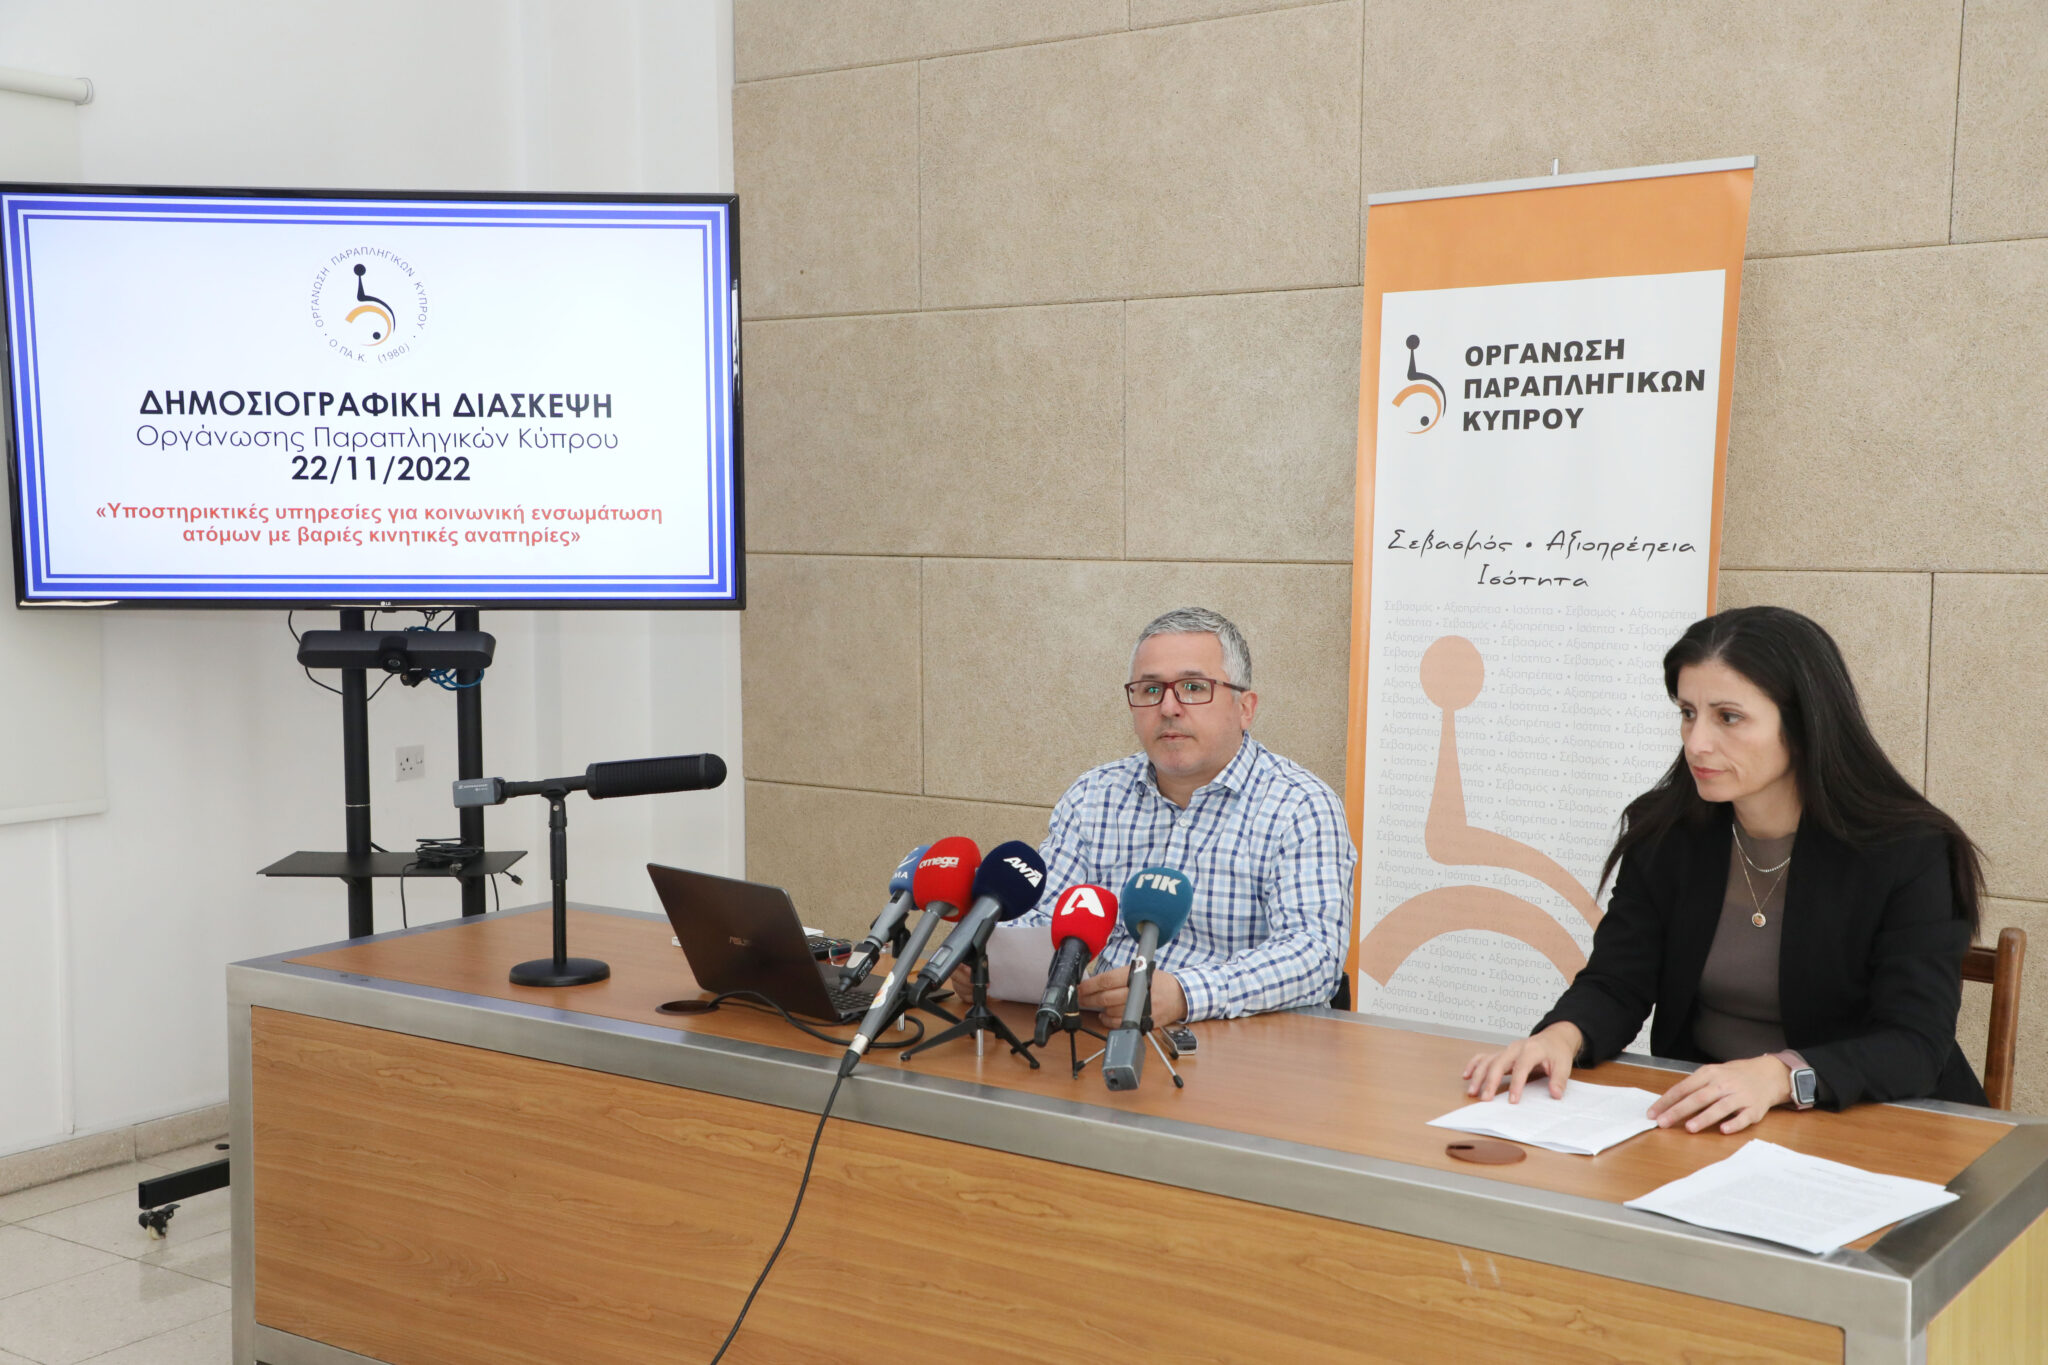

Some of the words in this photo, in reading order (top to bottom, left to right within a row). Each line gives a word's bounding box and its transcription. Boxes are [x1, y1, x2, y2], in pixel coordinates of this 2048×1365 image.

[311, 267, 330, 327] ΟΡΓΑΝΩΣΗ
[330, 246, 416, 278] ΠΑΡΑΠΛΗΓΙΚΩΝ
[414, 281, 428, 330] ΚΥΠΡΟΥ
[377, 343, 410, 364] (1980)
[1465, 338, 1625, 367] ΟΡΓΑΝΩΣΗ
[1464, 369, 1706, 400] ΠΑΡΑΠΛΗΓΙΚΩΝ
[139, 390, 442, 418] ΔΗΜΟΣΙΟΓΡΑΦΙΚΗ
[452, 393, 612, 419] ΔΙΑΣΚΕΨΗ
[1463, 407, 1585, 432] ΚΥΠΡΟΥ
[136, 423, 305, 453] Οργάνωσης
[314, 425, 509, 454] Παραπληγικών
[518, 427, 619, 454] Κύπρου
[291, 455, 471, 485] 22/11/2022
[96, 502, 270, 525] «Υποστηρικτικές
[276, 504, 382, 525] υπηρεσίες
[388, 508, 418, 524] για
[425, 504, 525, 525] κοινωνική
[532, 505, 663, 526] ενσωμάτωση
[183, 525, 262, 546] ατόμων
[269, 529, 291, 546] με
[298, 526, 363, 547] βαριές
[370, 527, 459, 547] κινητικές
[465, 527, 581, 548] αναπηρίες»
[1387, 529, 1513, 560] Σεβασμός
[1546, 530, 1697, 561] Αξιοπρέπεια
[1477, 564, 1589, 587] Ισότητα
[1384, 599, 1432, 614] Σεβασμός
[1444, 601, 1500, 616] Αξιοπρέπεια
[1512, 603, 1552, 616] Ισότητα
[1566, 605, 1616, 619] Σεβασμός
[1629, 606, 1696, 621] Αξιοπρέπεια
[1396, 615, 1432, 628] Ισότητα
[1443, 617, 1488, 631] Σεβασμός
[1501, 619, 1565, 634] Αξιοπρέπεια
[1576, 621, 1615, 634] Ισότητα
[1501, 635, 1554, 650] Σεβασμός
[1566, 637, 1629, 653] Αξιοπρέπεια
[1511, 651, 1551, 665] Ισότητα
[1563, 653, 1614, 668] Σεβασμός
[1498, 666, 1562, 682] Αξιοπρέπεια
[1574, 670, 1612, 684] Ισότητα
[1499, 682, 1552, 698] Σεβασμός
[1564, 686, 1627, 702] Αξιοπρέπεια
[1392, 707, 1428, 721] Ισότητα
[1497, 714, 1560, 730] Αξιοπρέπεια
[1572, 719, 1610, 733] Ισότητα
[1508, 699, 1549, 713] Ισότητα
[1562, 702, 1612, 718] Σεβασμός
[1383, 722, 1440, 738] Αξιοπρέπεια
[1497, 730, 1550, 746] Σεβασμός
[1562, 734, 1624, 751] Αξιοπρέπεια
[1380, 737, 1428, 754] Σεβασμός
[1507, 747, 1547, 761] Ισότητα
[1560, 750, 1610, 767] Σεβασμός
[1390, 753, 1426, 768] Ισότητα
[1495, 762, 1559, 778] Αξιοπρέπεια
[1571, 768, 1608, 782] Ισότητα
[1378, 783, 1426, 800] Σεβασμός
[1505, 794, 1545, 810] Ισότητα
[1558, 799, 1608, 816] Σεβασμός
[1496, 778, 1548, 795] Σεβασμός
[1560, 783, 1622, 800] Αξιοπρέπεια
[1388, 799, 1424, 814] Ισότητα
[1494, 809, 1557, 827] Αξιοπρέπεια
[1569, 816, 1606, 831] Ισότητα
[918, 856, 960, 869] omega
[1387, 845, 1422, 861] Ισότητα
[1374, 875, 1422, 893] Σεβασμός
[1378, 860, 1434, 878] Αξιοπρέπεια
[1444, 867, 1481, 883] Ισότητα
[1429, 943, 1476, 962] Σεβασμός
[1489, 951, 1551, 971] Αξιοπρέπεια
[1440, 960, 1477, 977] Ισότητα
[1489, 967, 1542, 987] Σεβασμός
[1428, 974, 1487, 994] Αξιοπρέπεια
[1499, 984, 1538, 1001] Ισότητα
[1428, 989, 1475, 1009] Σεβασμός
[1372, 997, 1428, 1017] Αξιοπρέπεια
[1439, 1007, 1475, 1024] Ισότητα
